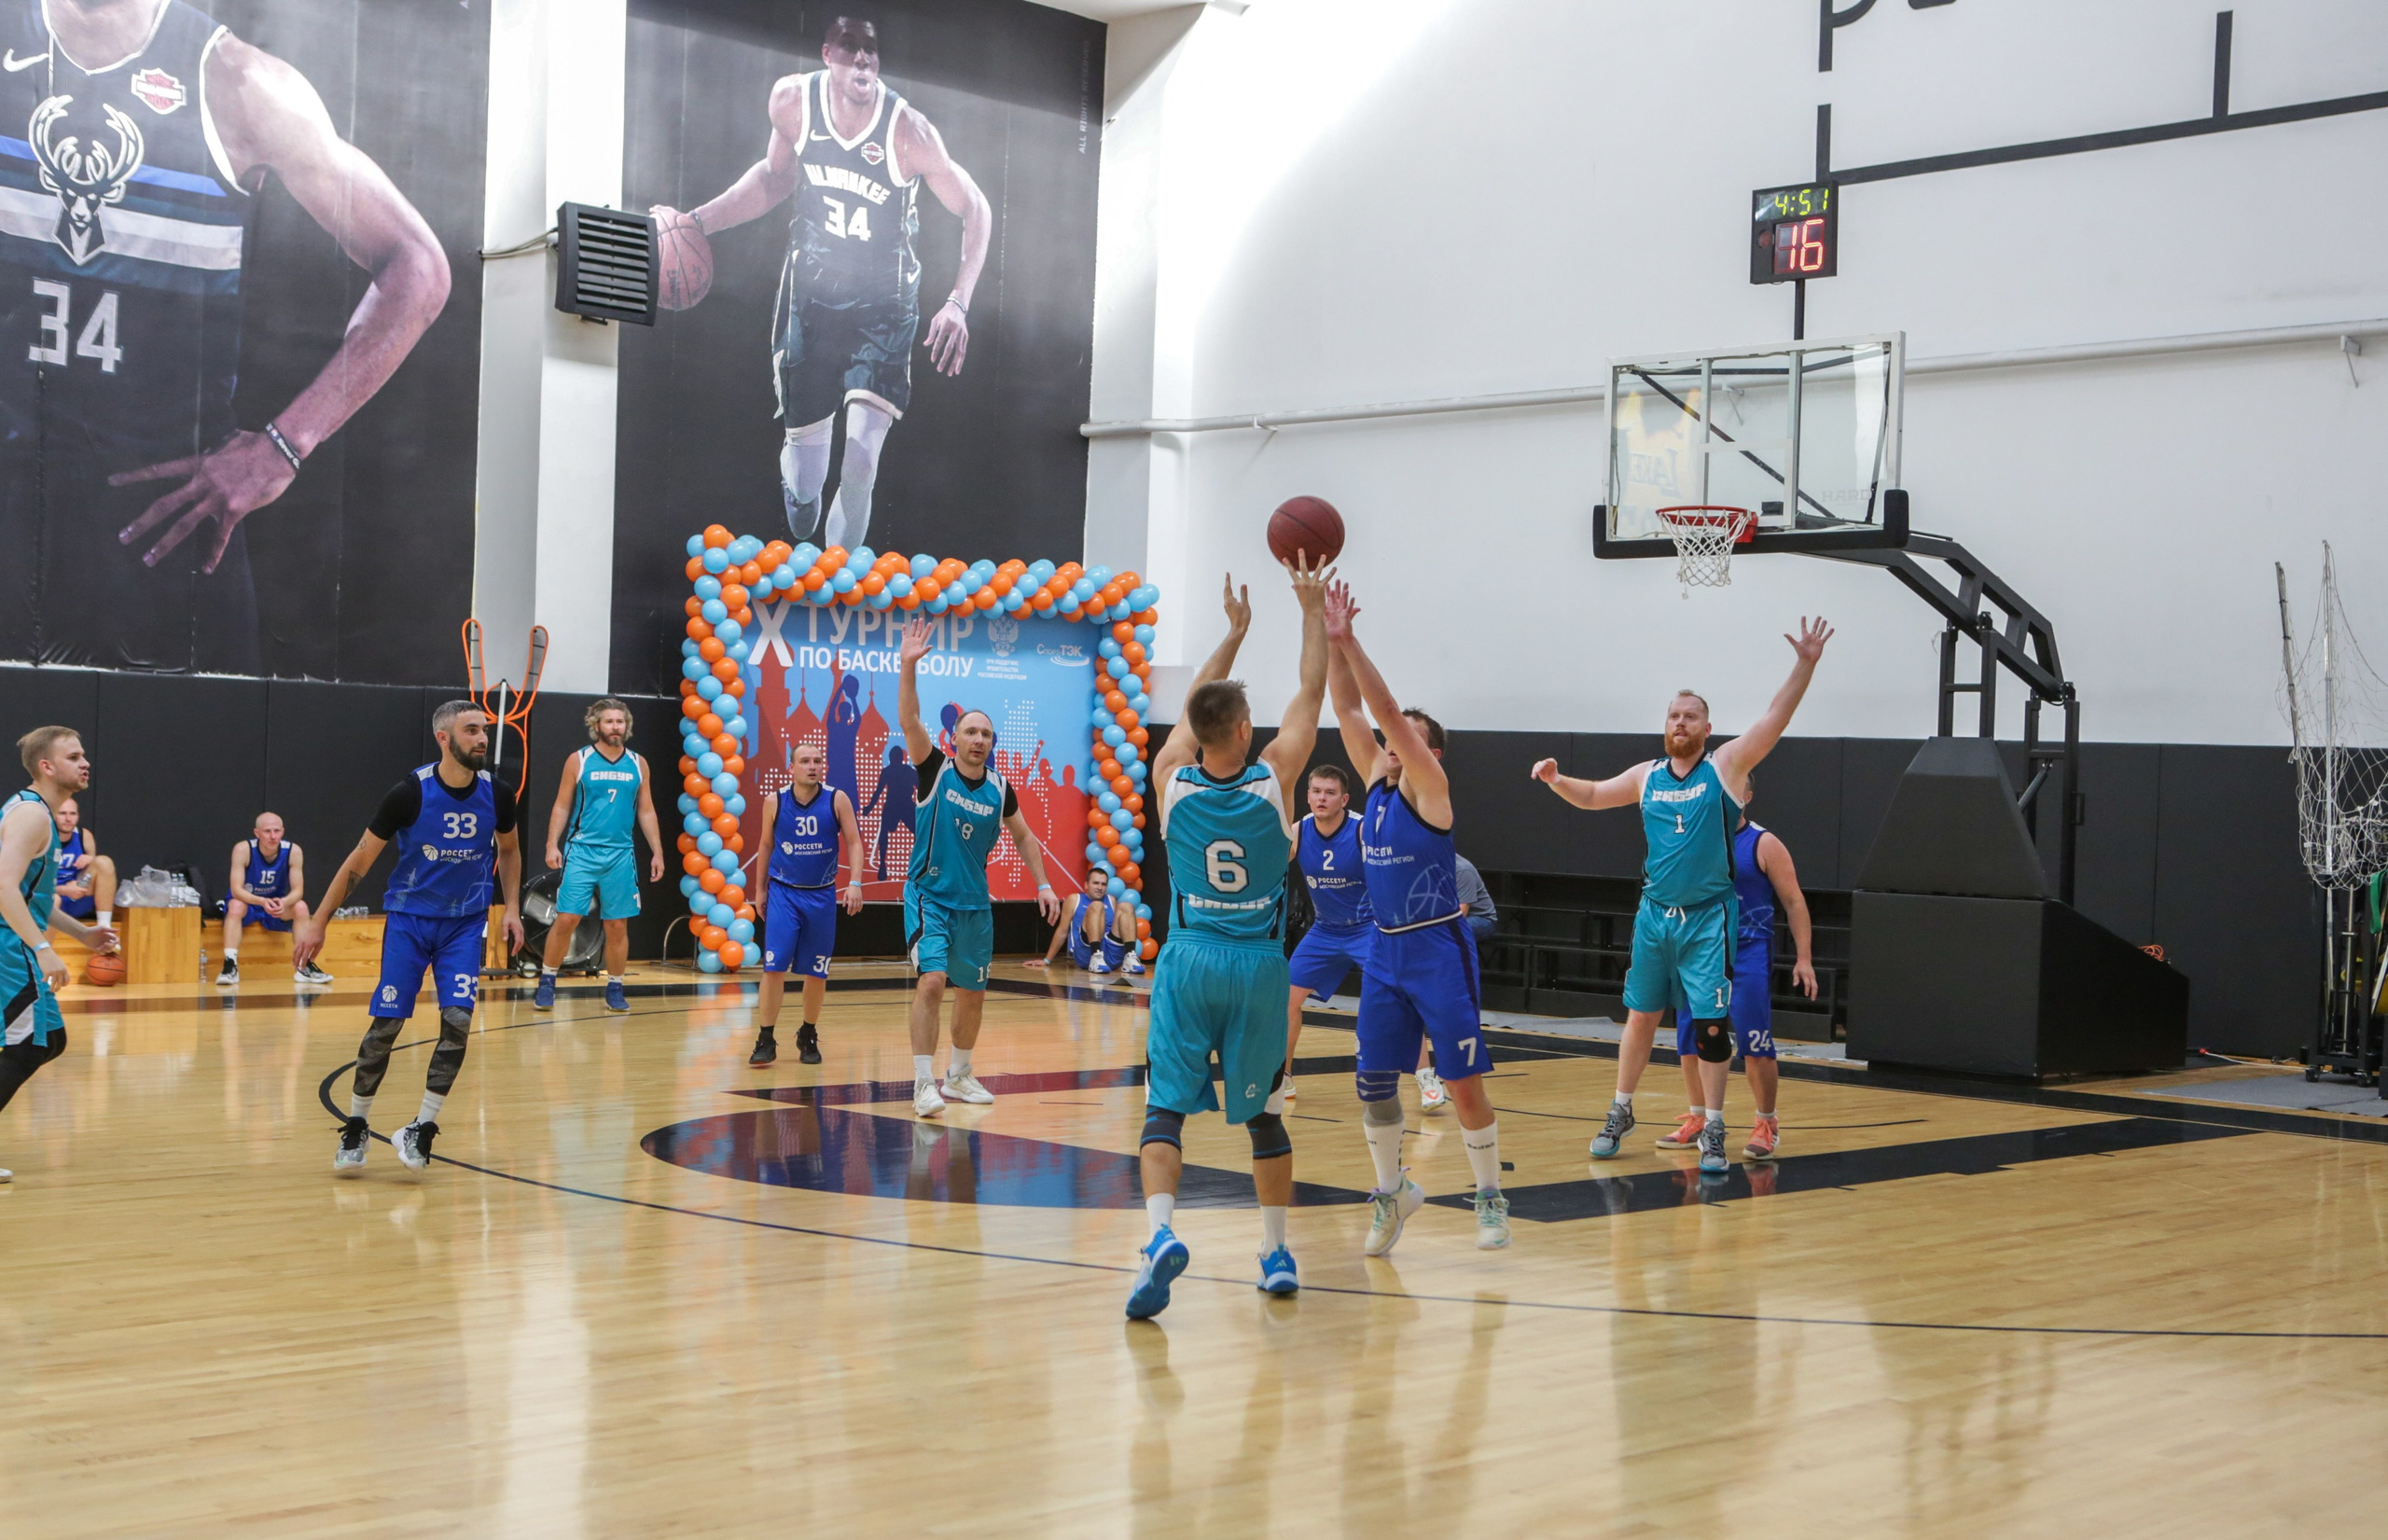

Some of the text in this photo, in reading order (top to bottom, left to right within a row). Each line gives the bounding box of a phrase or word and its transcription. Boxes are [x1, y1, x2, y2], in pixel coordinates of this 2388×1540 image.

[1079, 95, 1089, 132] RIGHTS
[1078, 135, 1088, 155] ALL
[1774, 188, 1829, 216] 4:51
[823, 195, 872, 242] 34
[1788, 218, 1826, 271] 16
[27, 277, 123, 374] 34
[799, 645, 974, 678] ПО БАСКЕБОЛУ
[590, 770, 634, 782] СИБУР
[607, 788, 618, 803] 7
[945, 788, 994, 817] СИБУР
[1651, 782, 1708, 802] СИБУР
[442, 812, 478, 839] 33
[795, 815, 819, 837] 30
[954, 817, 975, 840] 18
[1375, 805, 1387, 834] 7
[1674, 814, 1686, 834] 1
[1203, 839, 1250, 895] 6
[1323, 850, 1335, 871] 2
[1392, 855, 1415, 865] РЕГИОН
[259, 870, 277, 884] 15
[1715, 988, 1725, 1008] 1
[1457, 1036, 1478, 1067] 7
[1748, 1029, 1772, 1052] 24
